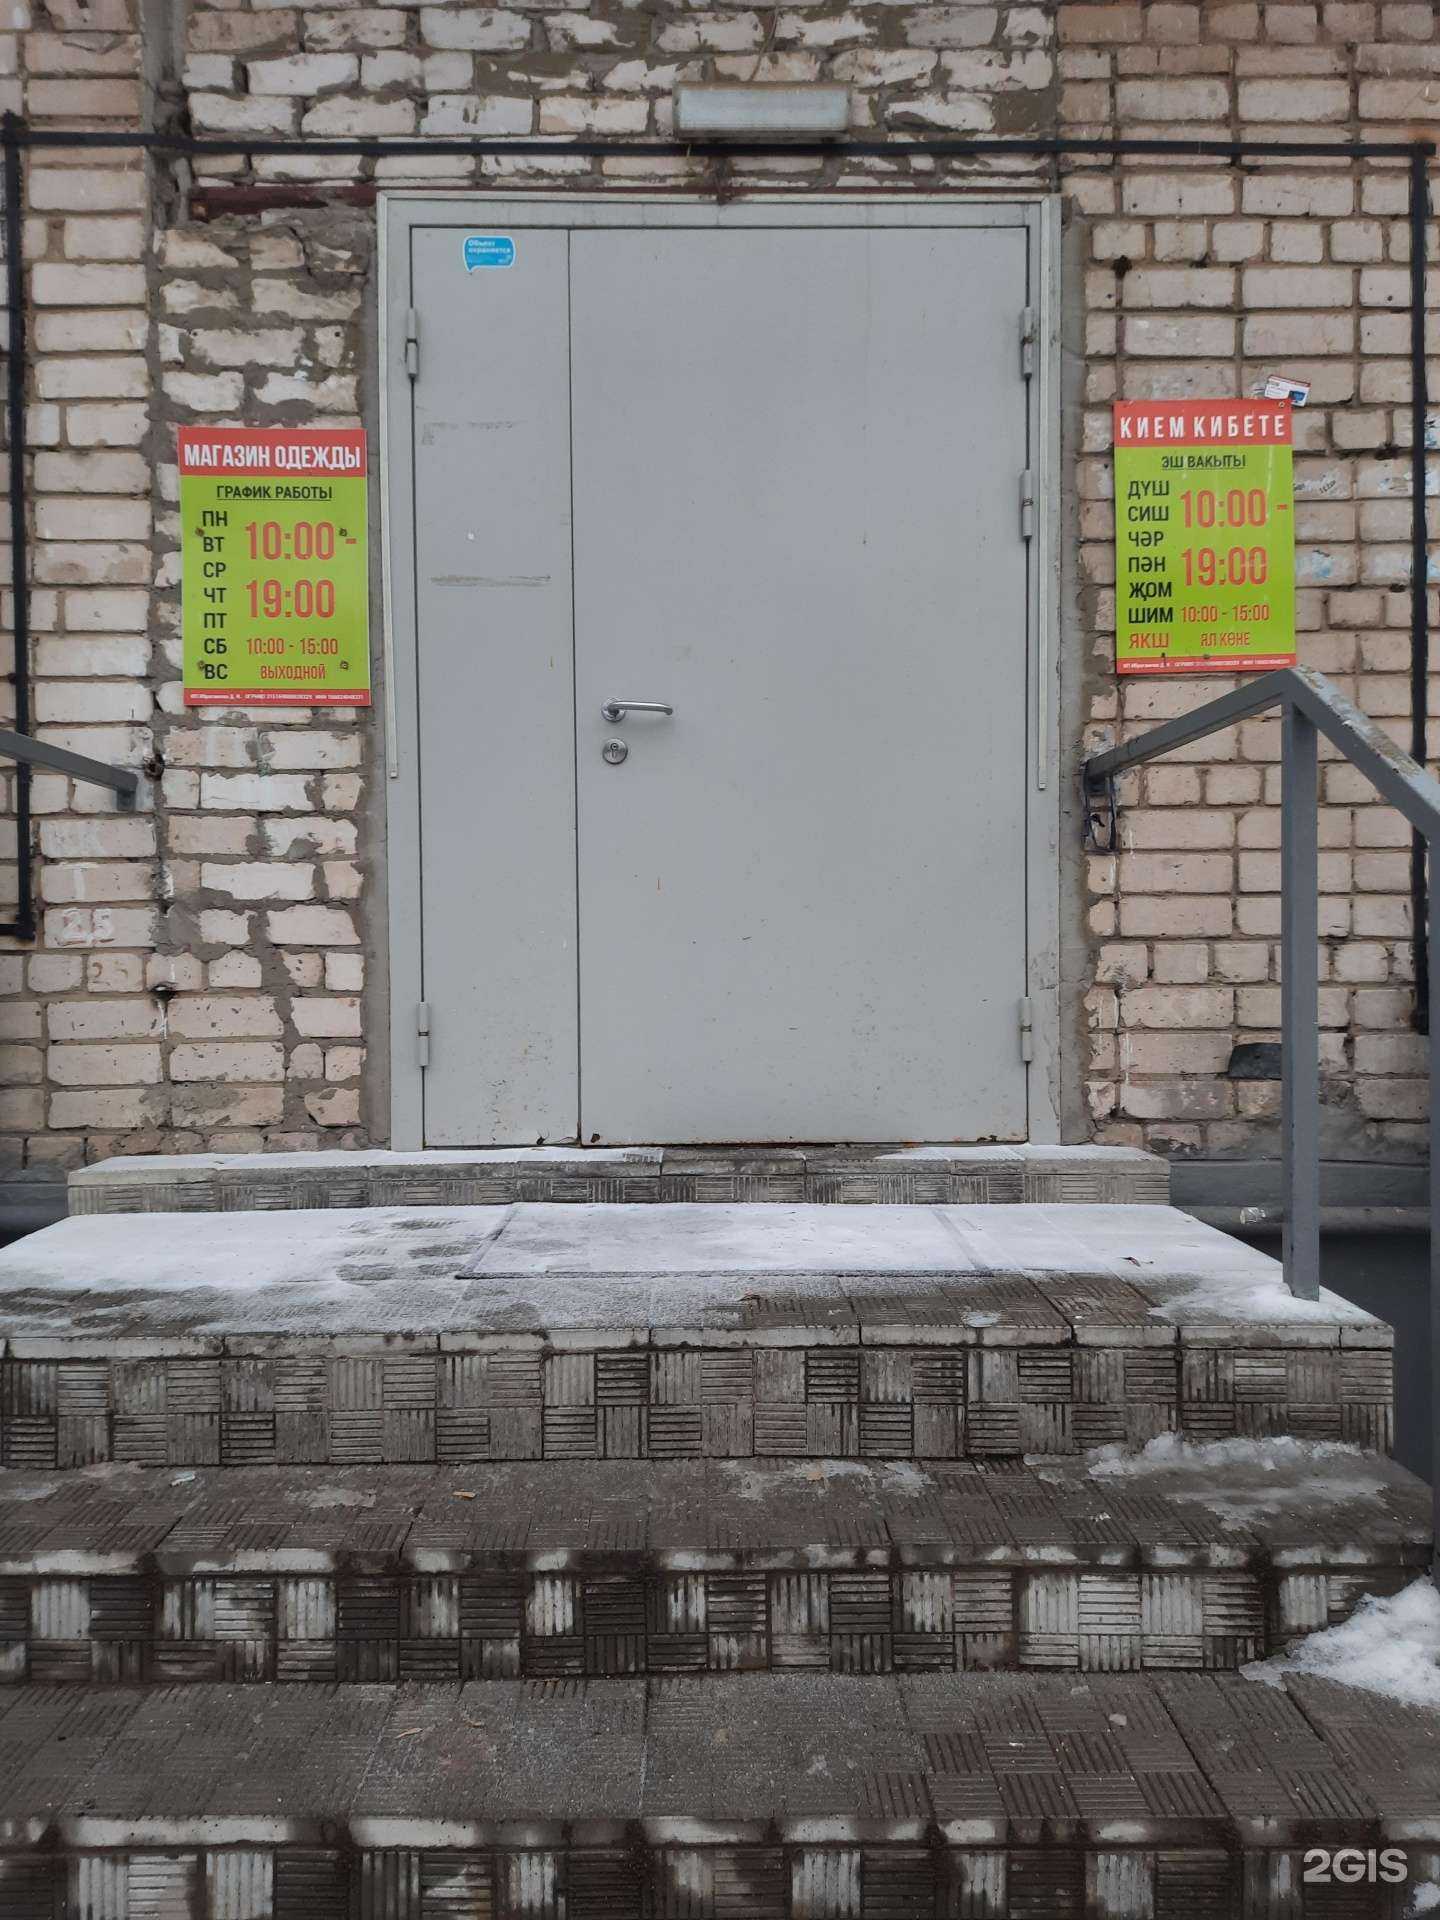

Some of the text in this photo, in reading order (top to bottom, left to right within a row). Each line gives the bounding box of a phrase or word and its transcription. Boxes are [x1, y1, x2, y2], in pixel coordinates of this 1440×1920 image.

[1120, 415, 1285, 438] КИЕМ КИБЕТЕ
[184, 444, 360, 470] МАГАЗИН ОДЕЖДЫ
[1162, 455, 1246, 468] ЭШ ВАКЫТЫ
[216, 485, 332, 499] ГРАФИК РАБОТЫ
[1128, 506, 1170, 521] СИШ
[1180, 489, 1267, 528] 10:00
[202, 510, 228, 527] ПН
[203, 536, 225, 552] ВТ
[245, 521, 335, 561] 10:00
[1128, 531, 1165, 547] ЧӘР
[203, 562, 227, 578] СР
[1128, 557, 1166, 573] ПӘН
[1180, 547, 1267, 587] 19:00
[203, 588, 227, 603] ЧТ
[245, 579, 335, 618] 19:00
[203, 613, 227, 629] ПТ
[1128, 607, 1174, 624] ШИМ
[1181, 606, 1218, 623] 10:00
[1232, 604, 1270, 622] 15:00
[203, 638, 228, 655] СБ
[246, 638, 285, 655] 10:00
[300, 638, 339, 655] 15:00
[1129, 633, 1170, 649] ЯКШ
[1200, 632, 1217, 647] ЯЛ
[204, 663, 326, 680] ВС ВЫХОДНОЙ
